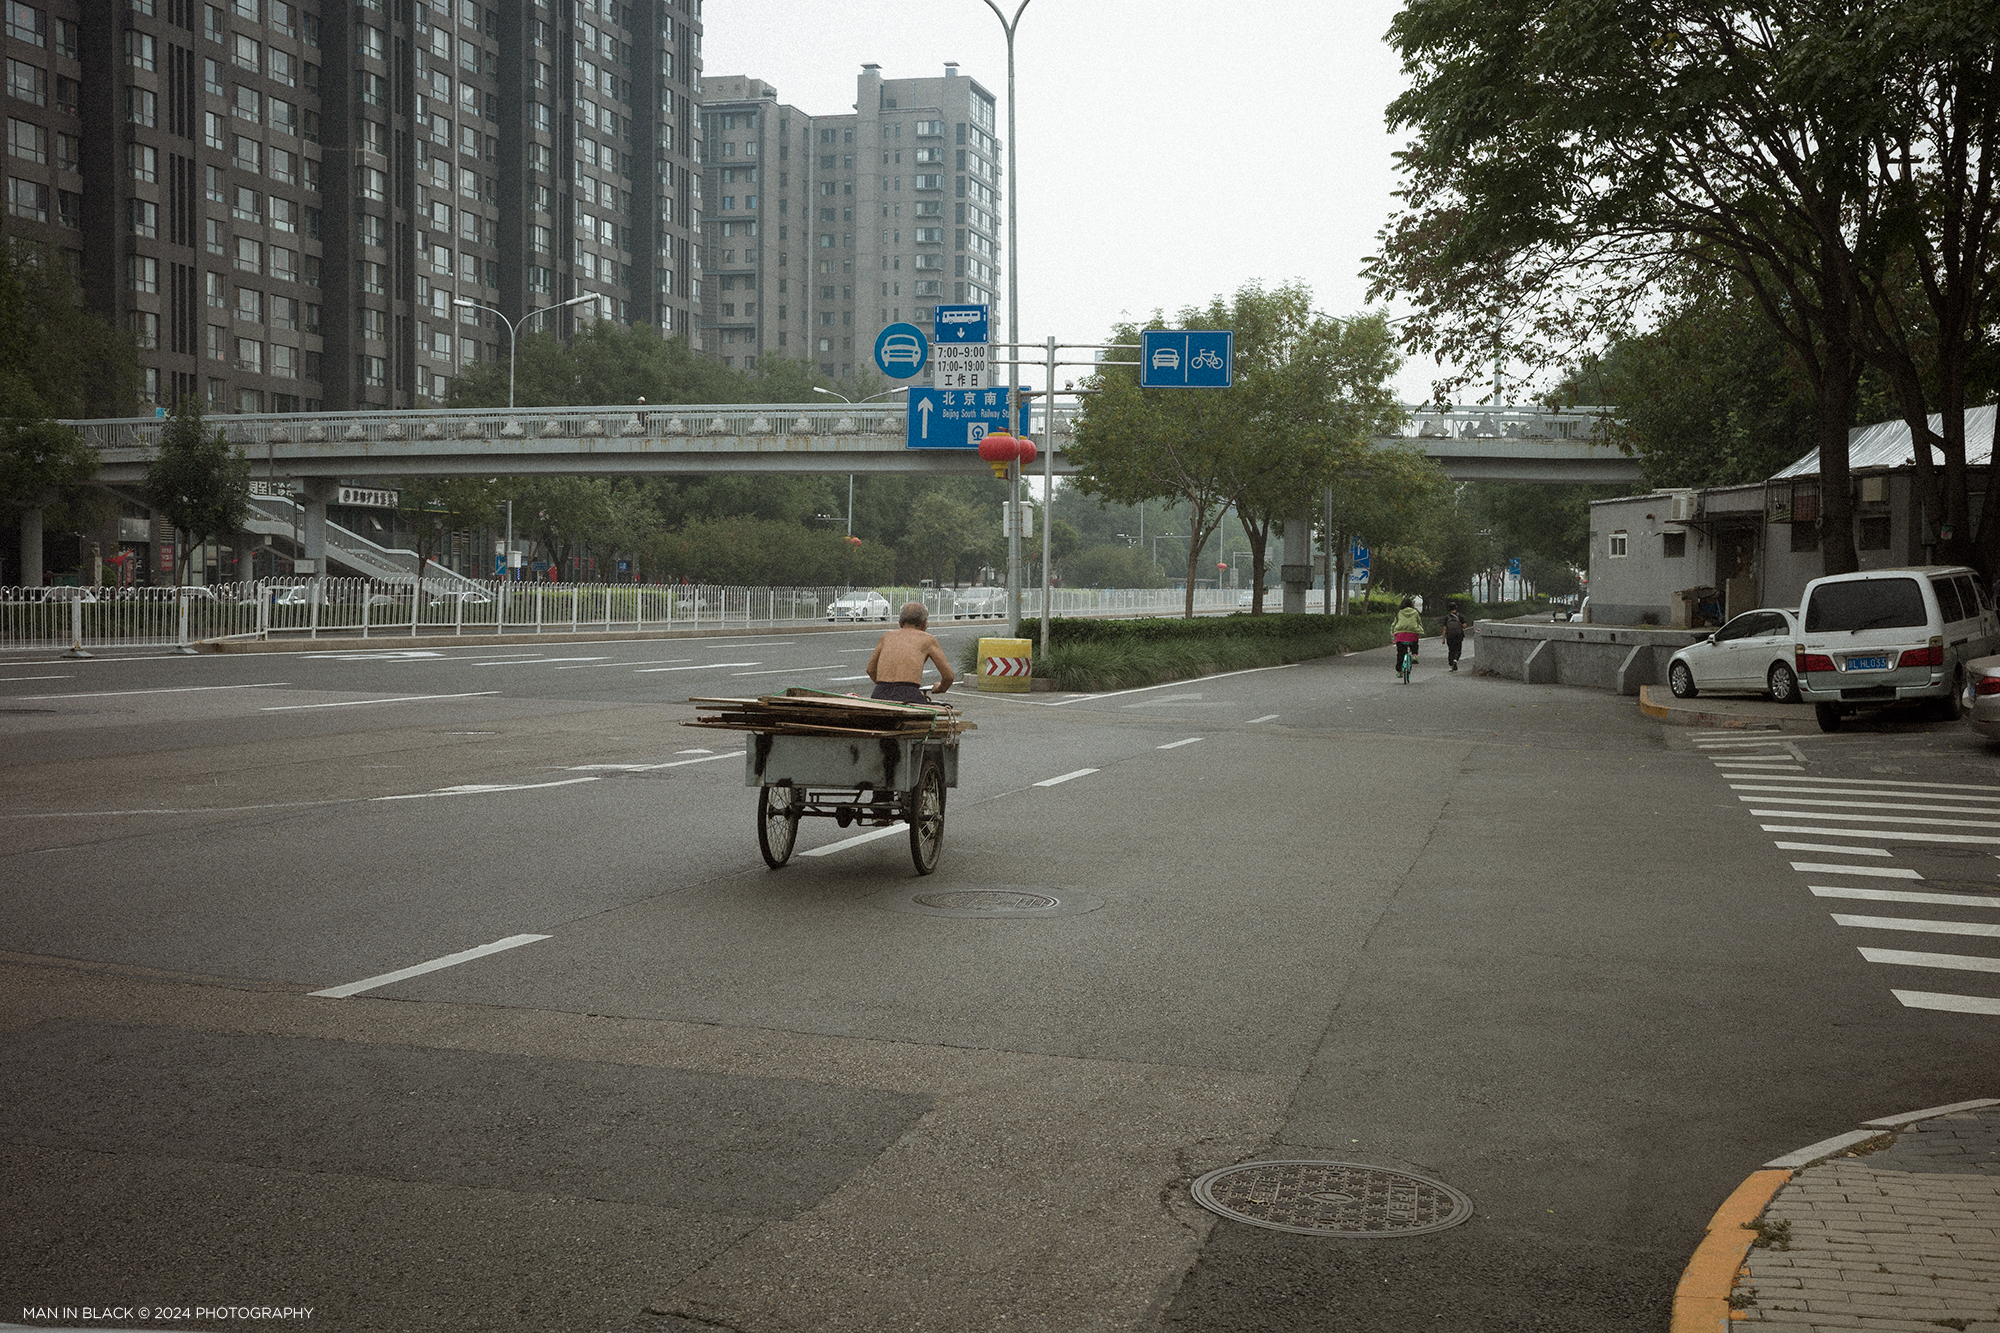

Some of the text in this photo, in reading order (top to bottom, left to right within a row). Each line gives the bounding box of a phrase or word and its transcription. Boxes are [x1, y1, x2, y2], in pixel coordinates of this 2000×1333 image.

[938, 346, 985, 358] 7:00-9:00
[938, 360, 985, 371] 17:00-19:00
[944, 373, 978, 387] 工作日
[942, 408, 959, 420] Beijing
[961, 408, 977, 418] South
[980, 408, 1000, 420] Railway
